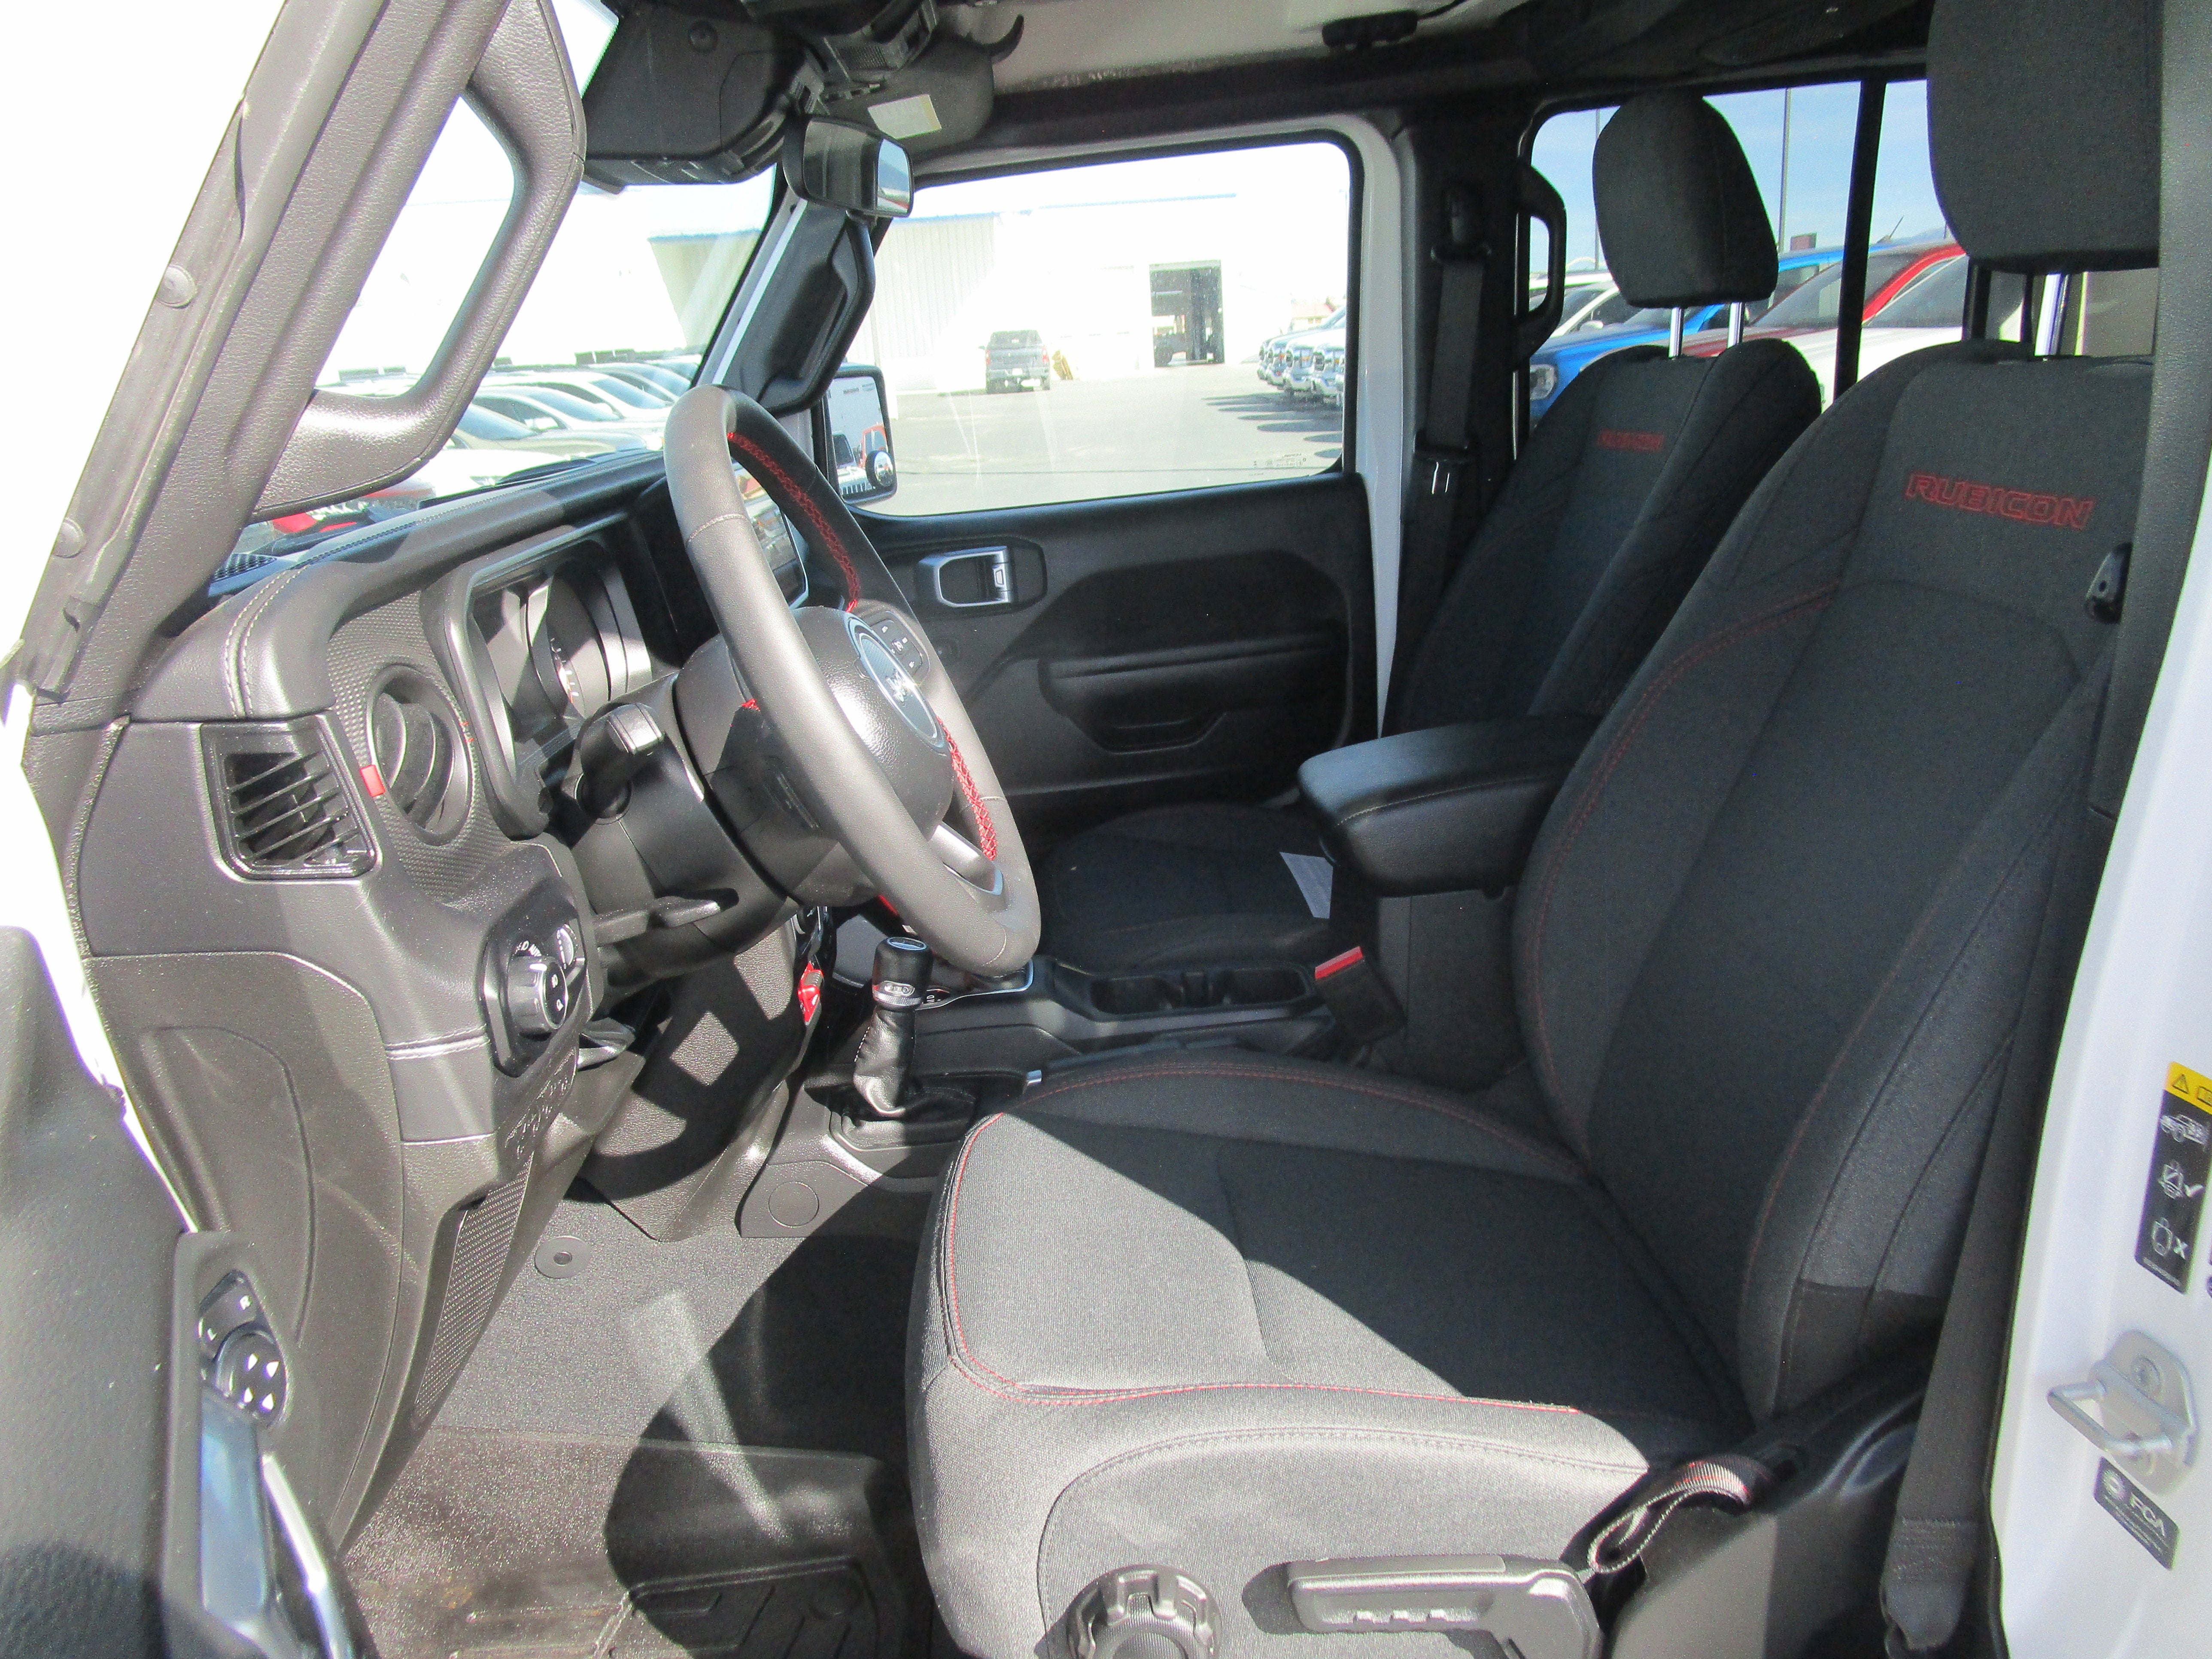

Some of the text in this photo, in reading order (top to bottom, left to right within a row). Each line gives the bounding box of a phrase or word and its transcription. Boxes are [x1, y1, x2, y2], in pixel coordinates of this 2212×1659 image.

[1904, 471, 2094, 530] RUBICON
[239, 1295, 252, 1310] R
[207, 1328, 218, 1341] L
[2129, 1492, 2166, 1537] FCA
